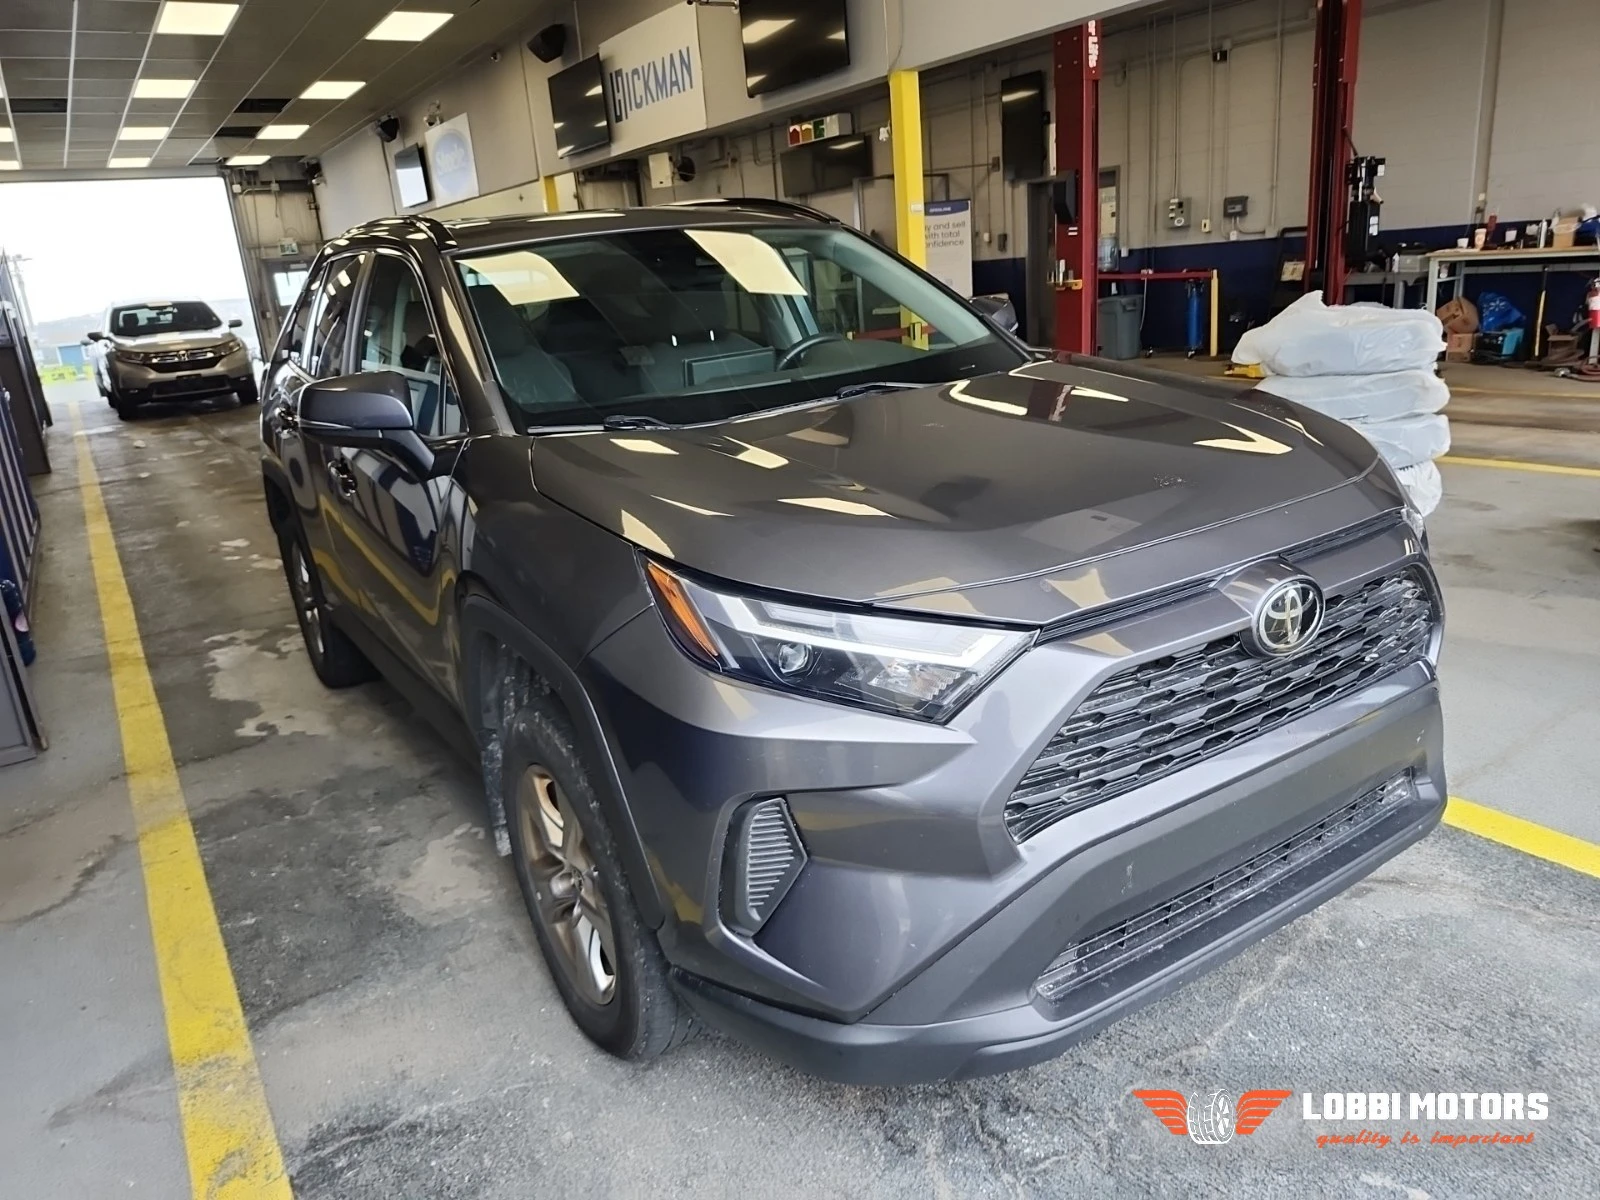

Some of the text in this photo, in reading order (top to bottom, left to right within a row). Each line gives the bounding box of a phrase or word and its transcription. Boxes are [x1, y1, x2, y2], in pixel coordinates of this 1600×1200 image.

[933, 221, 950, 231] and
[952, 220, 966, 229] sell
[941, 230, 961, 239] total
